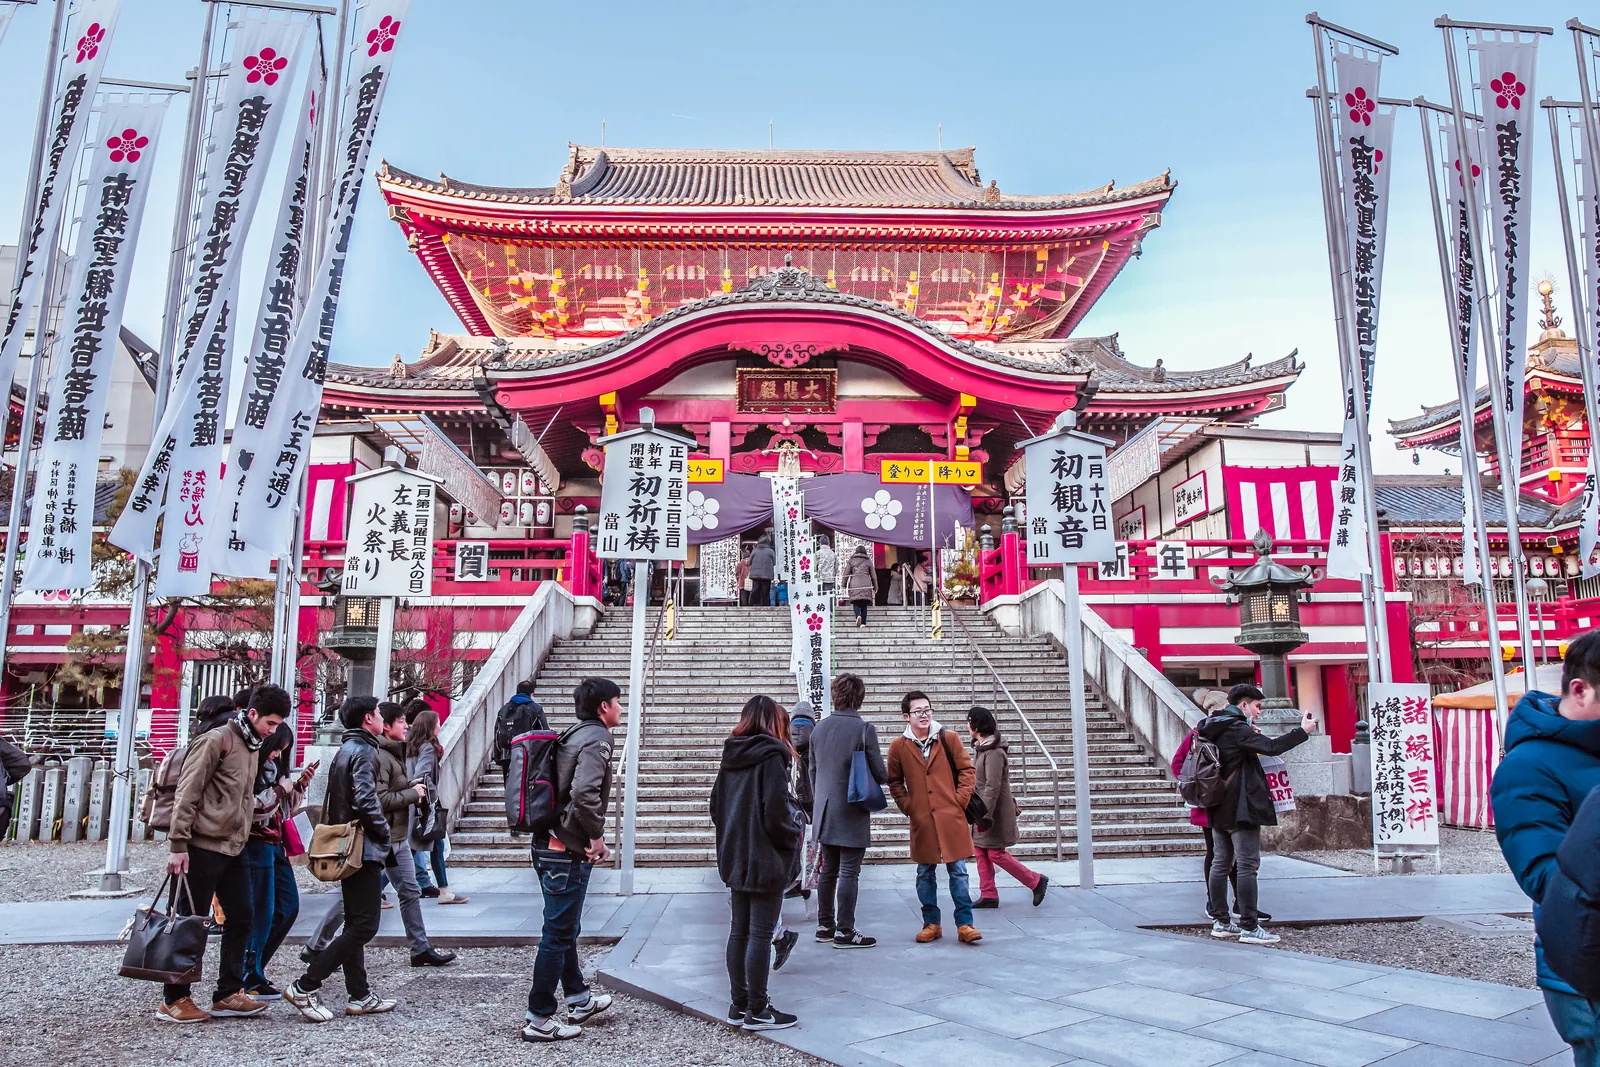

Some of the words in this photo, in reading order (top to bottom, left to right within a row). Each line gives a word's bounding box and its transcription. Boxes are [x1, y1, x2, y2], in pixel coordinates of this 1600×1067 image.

[266, 410, 311, 509] 仁王門通り
[629, 443, 645, 469] 開運
[647, 442, 664, 469] 新年
[888, 464, 925, 479] 登り口
[938, 466, 976, 480] 降り口
[1050, 449, 1088, 549] 初観音
[1087, 455, 1107, 531] 一月十八日
[362, 502, 387, 581] 火祭り
[387, 484, 413, 562] 左義長
[603, 513, 620, 552] 當山
[1031, 516, 1049, 558] 當山
[345, 556, 360, 590] 當山
[458, 544, 485, 579] 賀
[809, 631, 825, 725] 南無聖観世音
[1385, 697, 1406, 834] 縁結びは本堂内左側の
[1401, 695, 1434, 832] 諸縁吉祥
